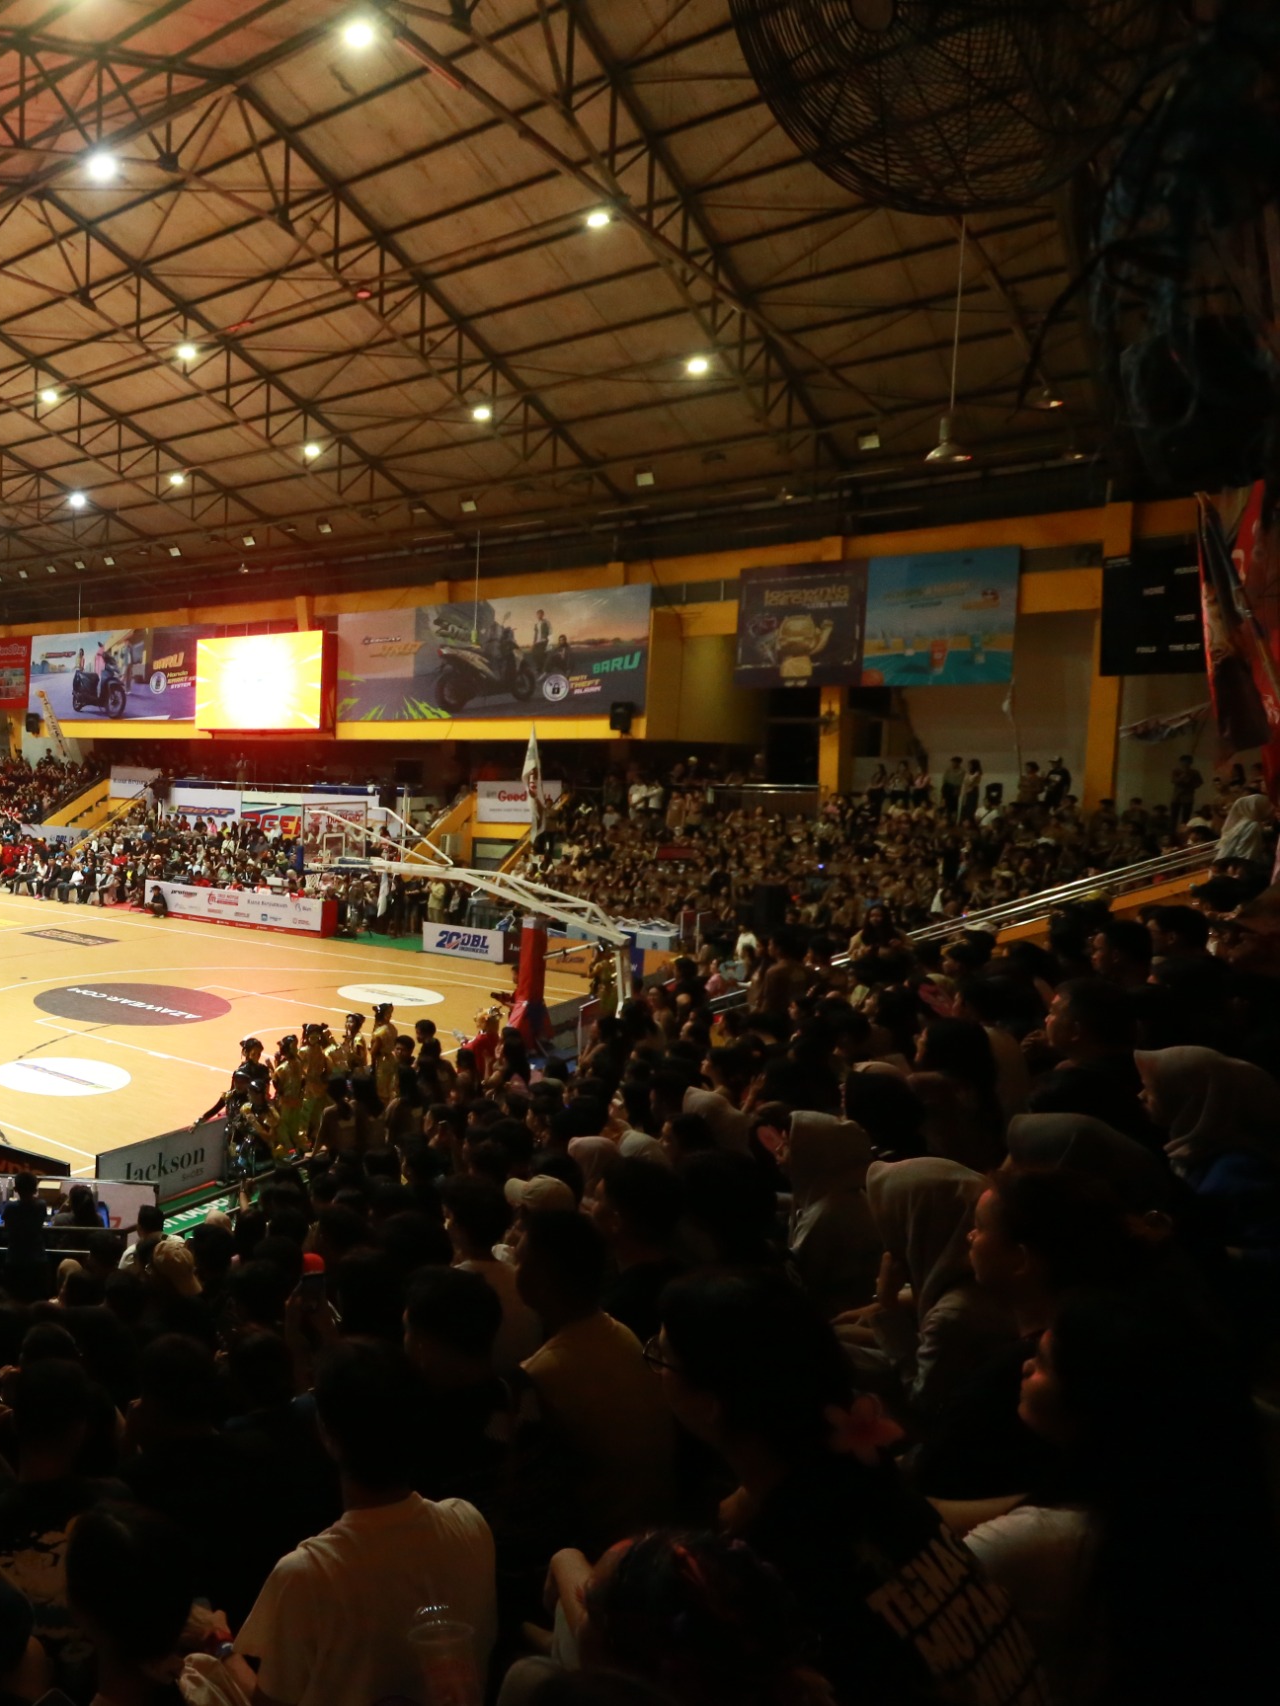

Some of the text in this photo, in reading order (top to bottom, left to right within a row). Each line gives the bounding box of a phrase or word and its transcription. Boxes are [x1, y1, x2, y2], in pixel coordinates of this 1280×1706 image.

[592, 650, 641, 674] BARU
[498, 790, 528, 802] Good
[435, 930, 461, 950] 20
[460, 933, 489, 949] DBL
[67, 987, 202, 1020] AZAWEAR.COM
[126, 1147, 205, 1181] Jackson
